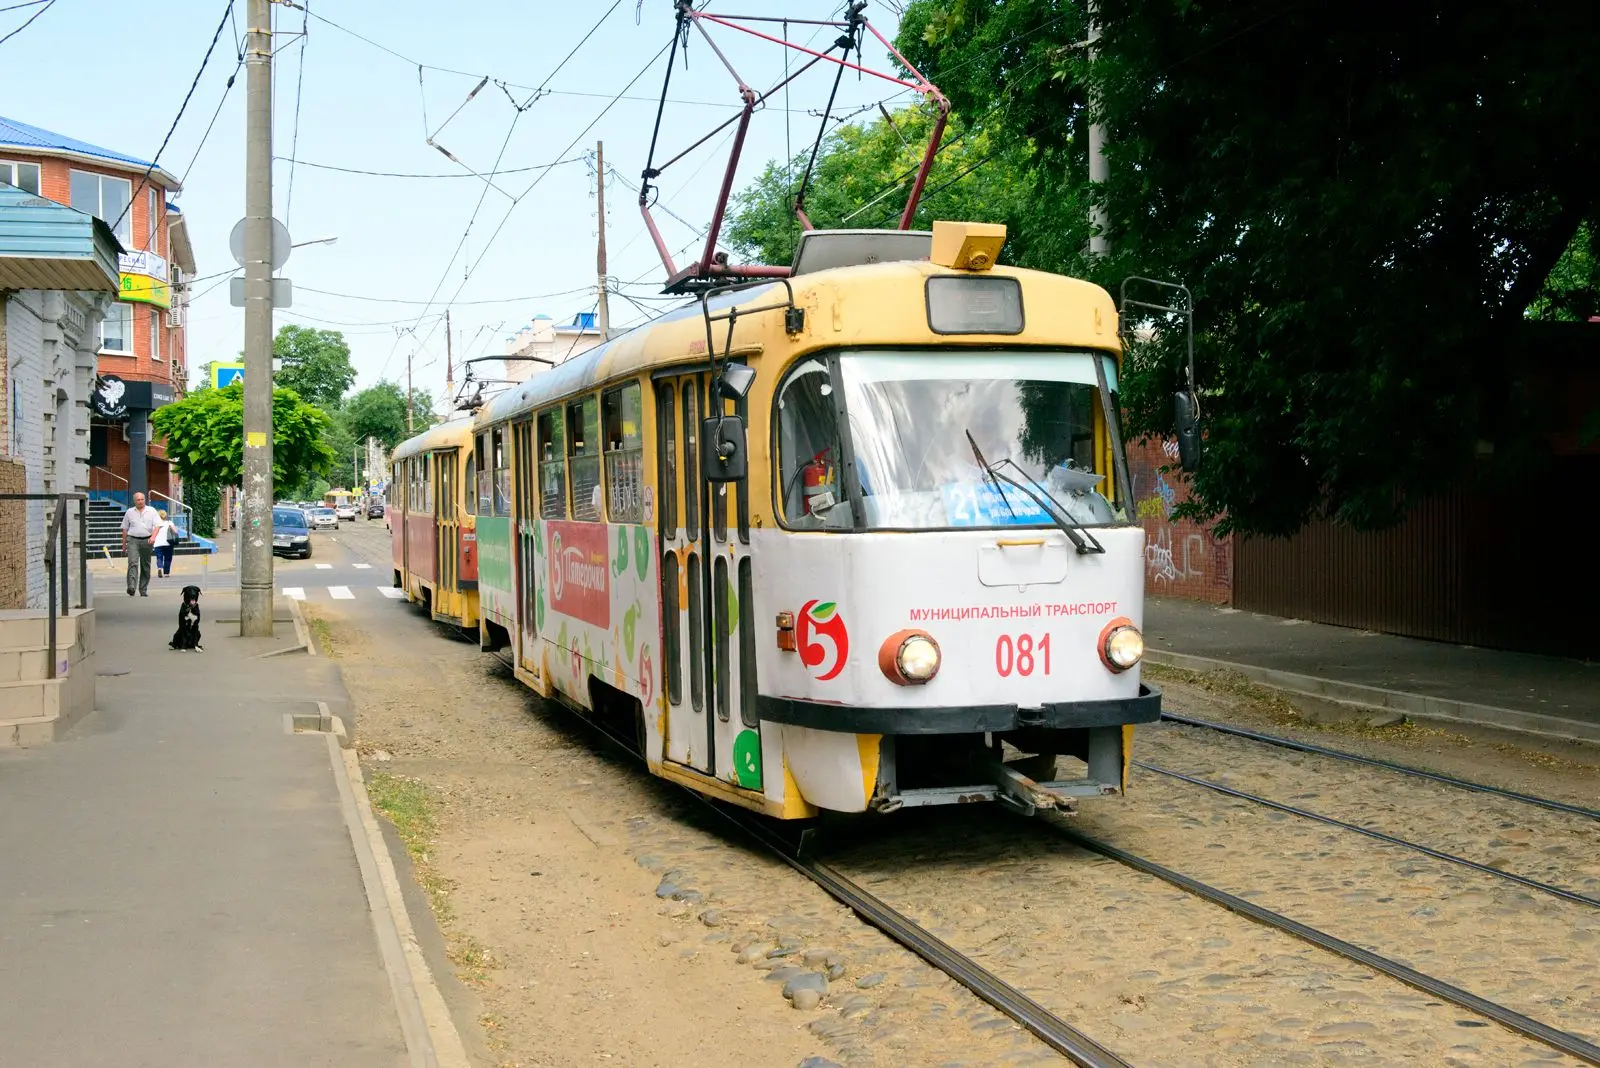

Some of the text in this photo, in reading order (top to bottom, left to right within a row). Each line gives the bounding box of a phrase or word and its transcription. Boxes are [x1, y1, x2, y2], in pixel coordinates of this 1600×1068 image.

[950, 485, 981, 520] 21
[910, 602, 1117, 621] МУНИЦИПАЛЬНЫЙ ТРАНСПОРТ
[996, 633, 1050, 677] 081
